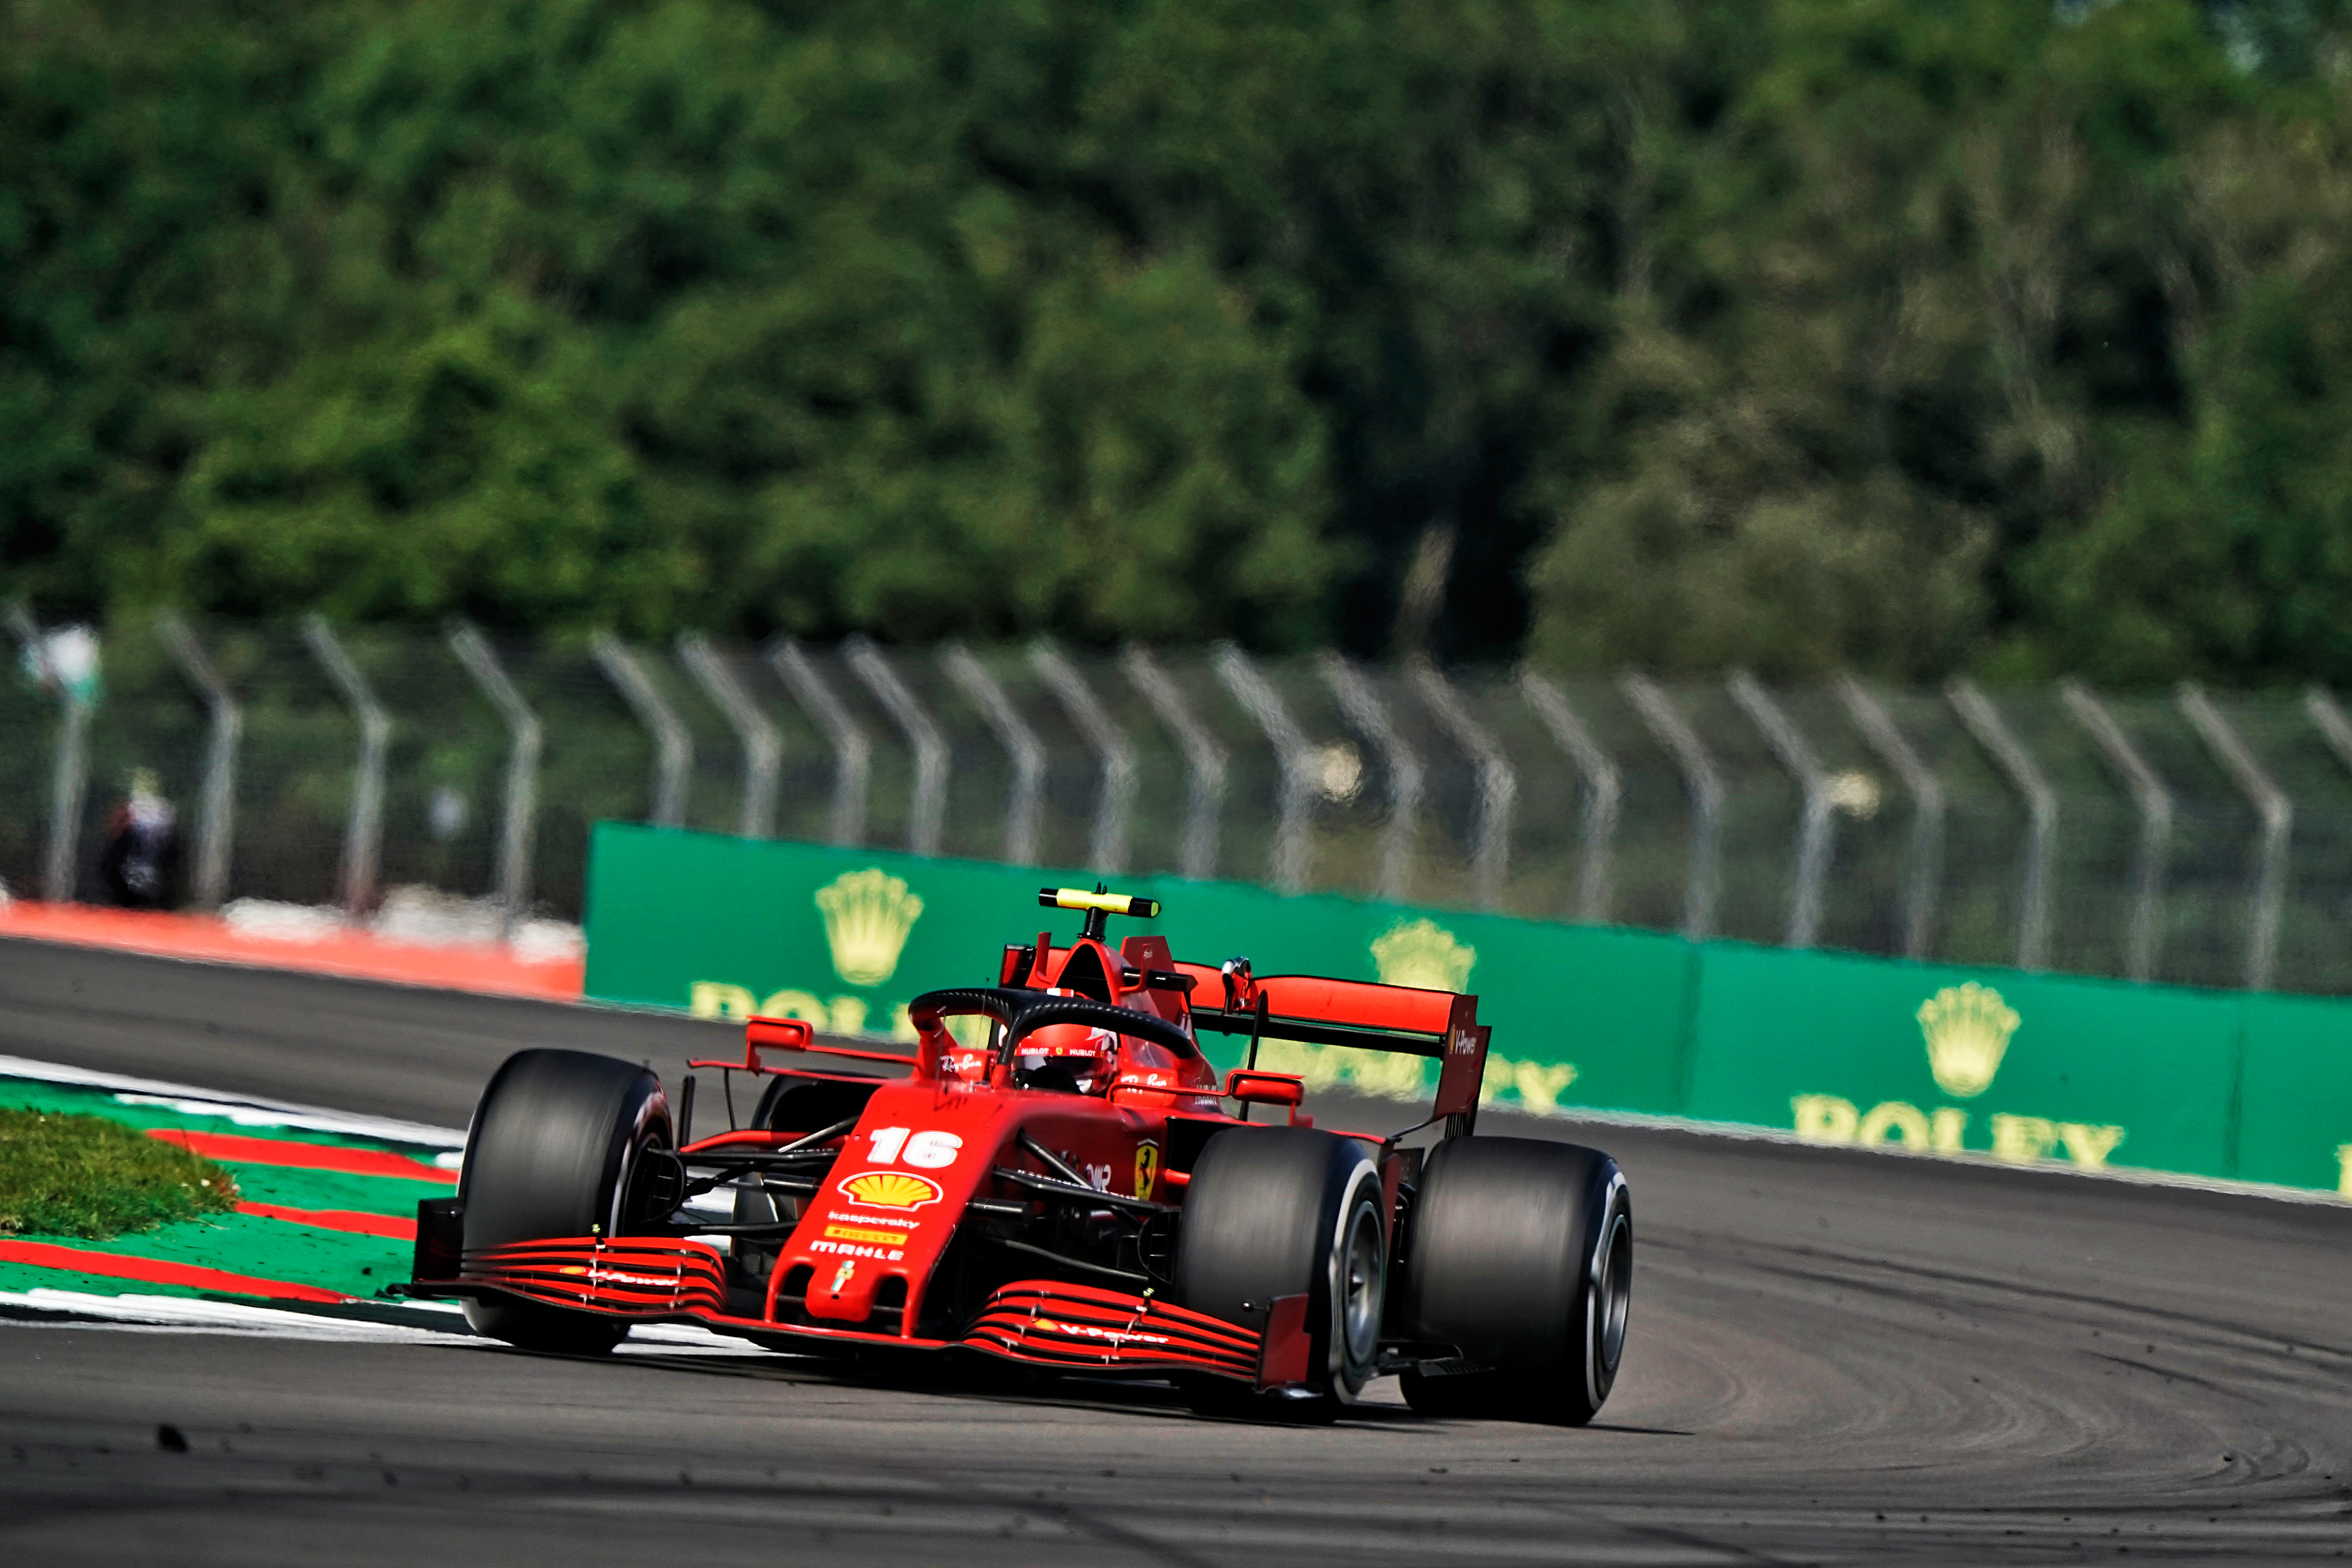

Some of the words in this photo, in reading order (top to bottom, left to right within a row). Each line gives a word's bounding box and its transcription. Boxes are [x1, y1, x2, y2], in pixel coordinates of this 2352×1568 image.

[867, 1126, 963, 1169] 16
[828, 1210, 920, 1229] kaspersky
[809, 1240, 904, 1261] MAHLE
[1060, 1324, 1169, 1343] V-Power
